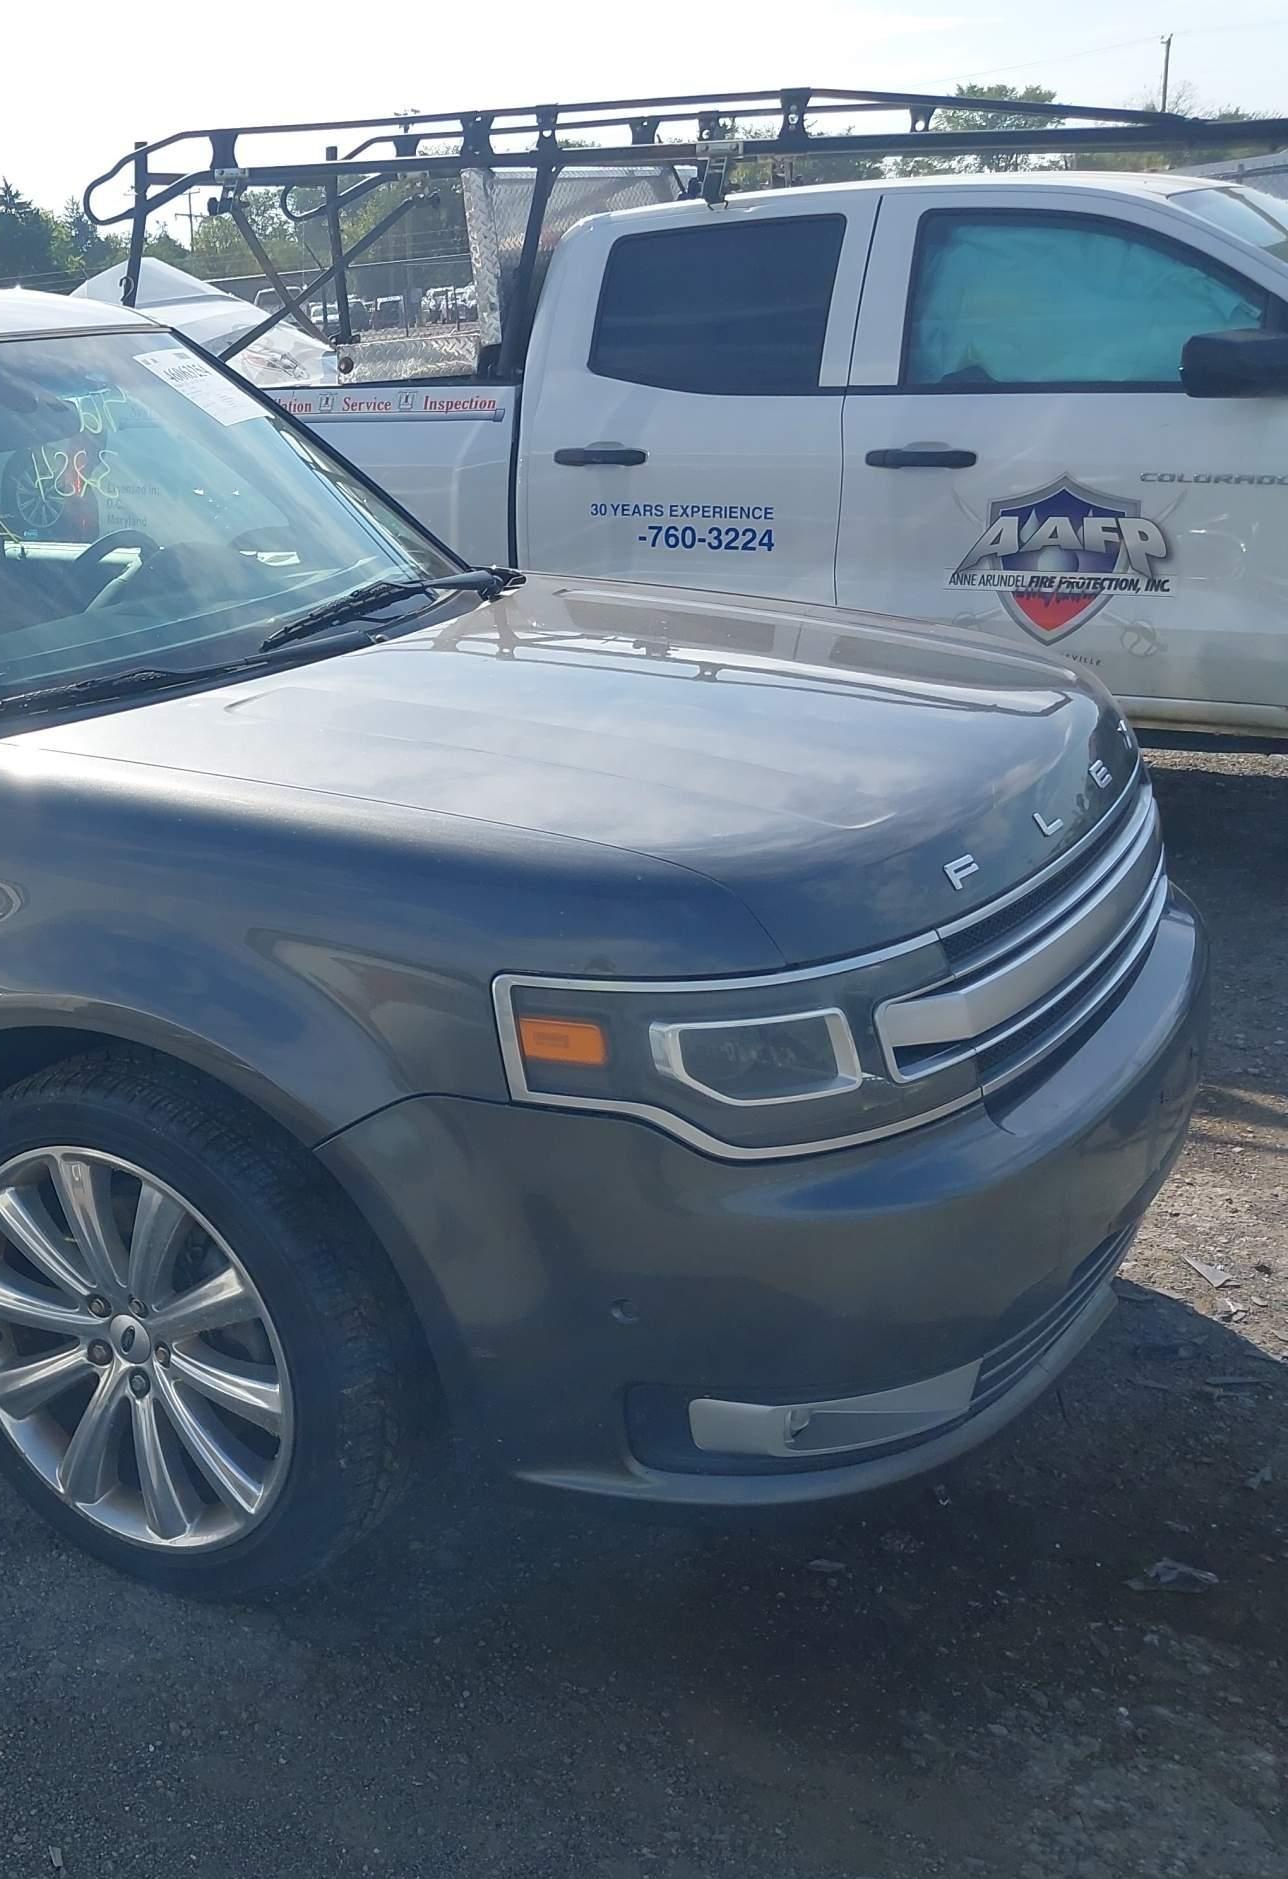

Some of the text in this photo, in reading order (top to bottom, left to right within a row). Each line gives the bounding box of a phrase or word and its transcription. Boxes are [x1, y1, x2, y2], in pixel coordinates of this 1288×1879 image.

[342, 396, 391, 411] Service
[423, 394, 496, 413] Inspection
[590, 503, 774, 520] 30 YEARS EXPERIENCE
[638, 525, 775, 552] -760-3224
[954, 515, 1166, 578] AAFP
[948, 573, 977, 586] ANNE
[979, 574, 1026, 588] ARUNDEL
[1027, 575, 1056, 589] FIRE
[1058, 576, 1142, 594] PROTECTION,
